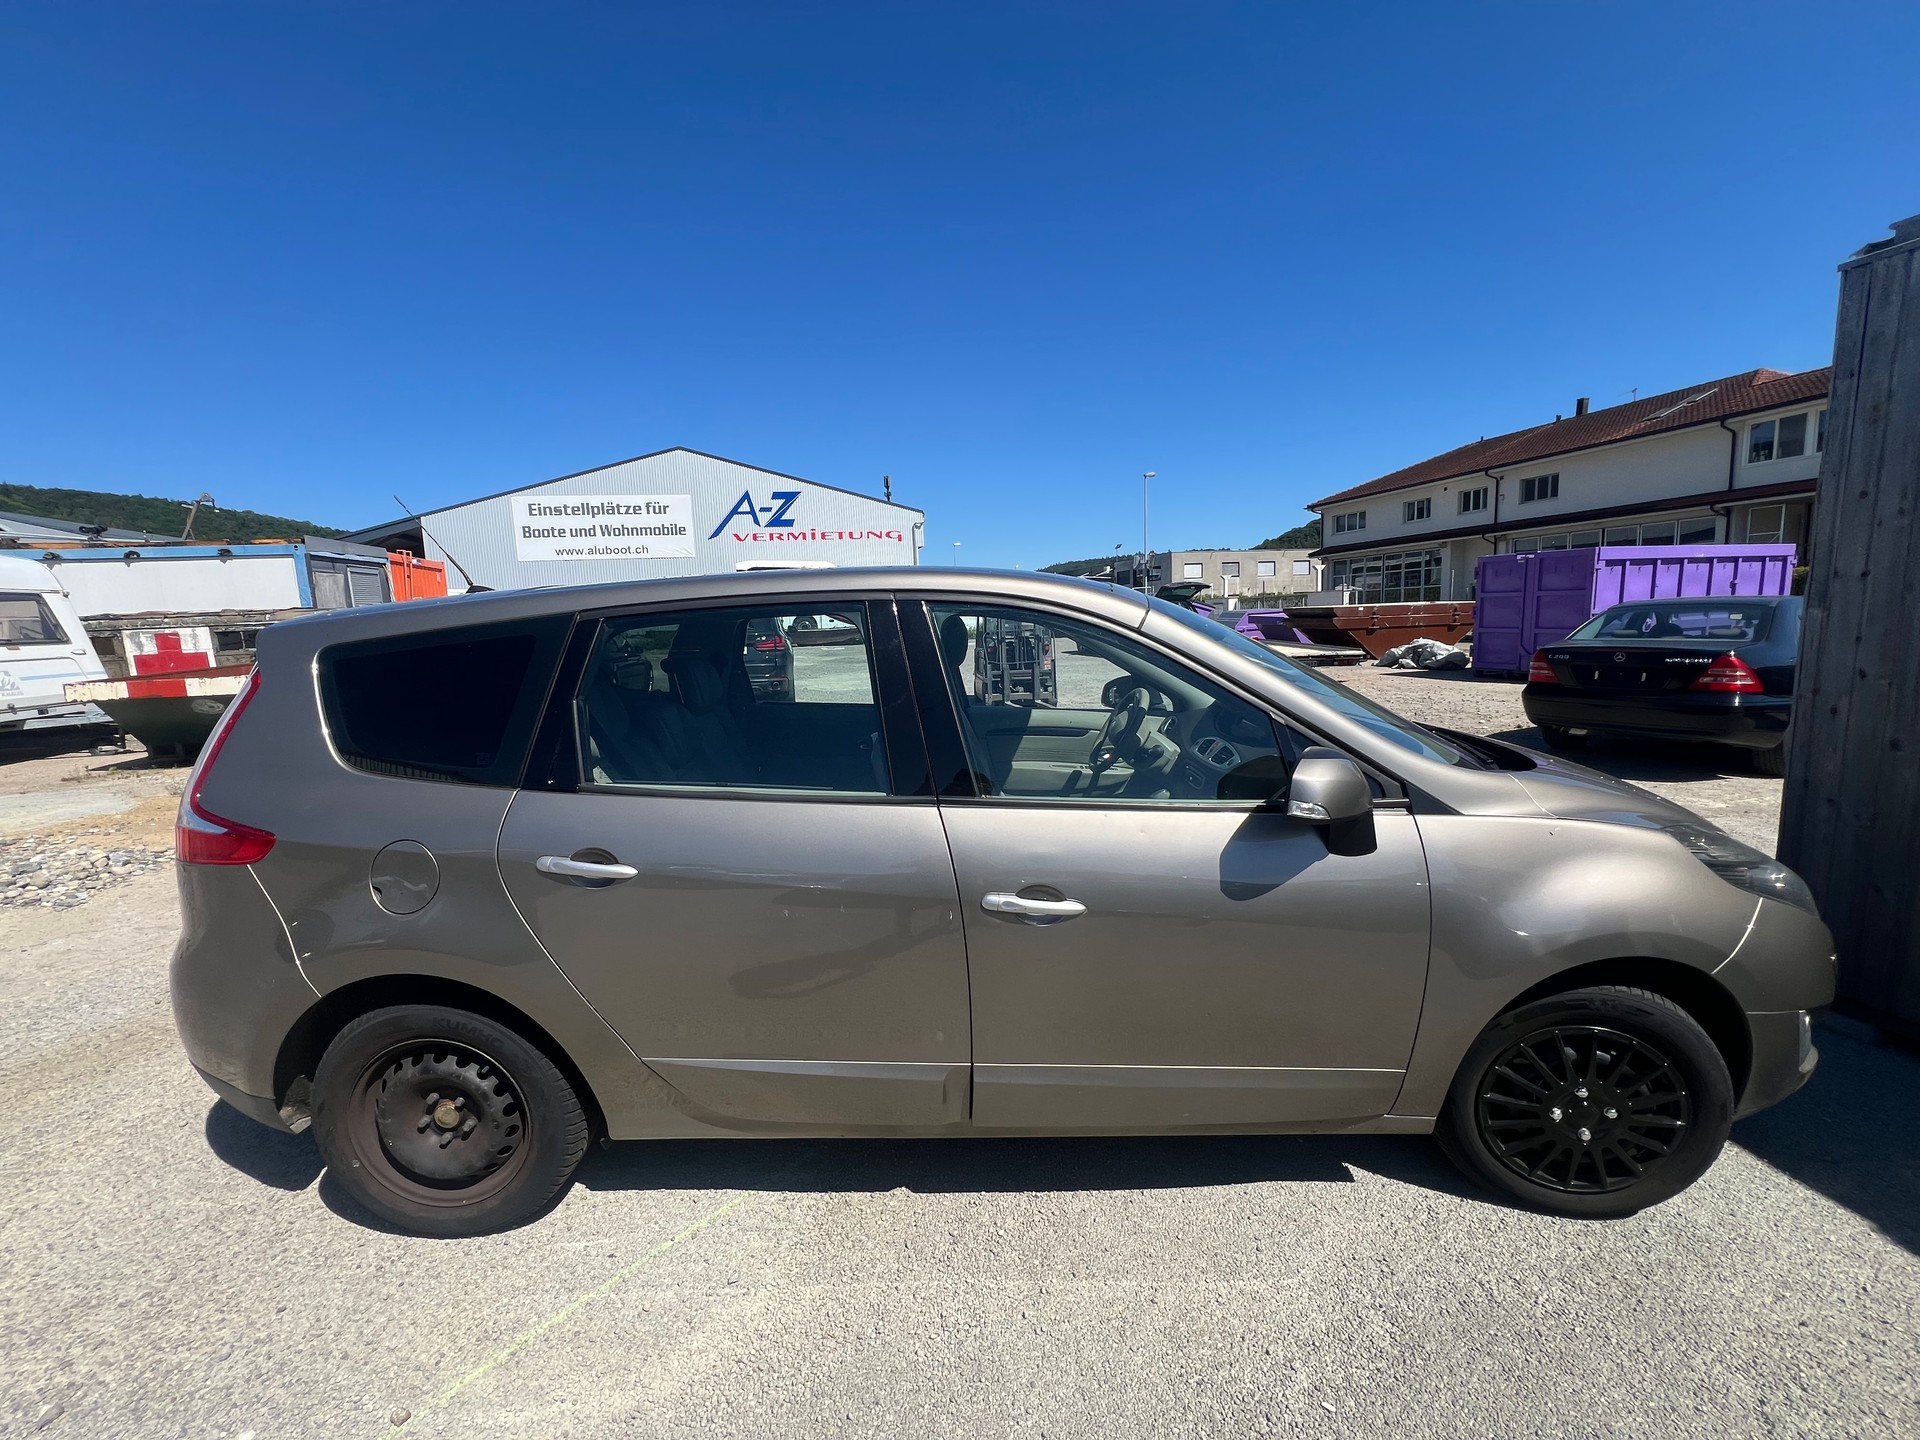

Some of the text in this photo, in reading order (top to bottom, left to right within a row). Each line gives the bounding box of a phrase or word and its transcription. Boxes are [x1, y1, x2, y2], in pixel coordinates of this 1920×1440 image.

[527, 501, 670, 518] Einstellplätze für
[708, 490, 802, 540] A-Z
[521, 523, 687, 539] Boote und Wohnmobile
[555, 544, 649, 556] www.aluboot.ch
